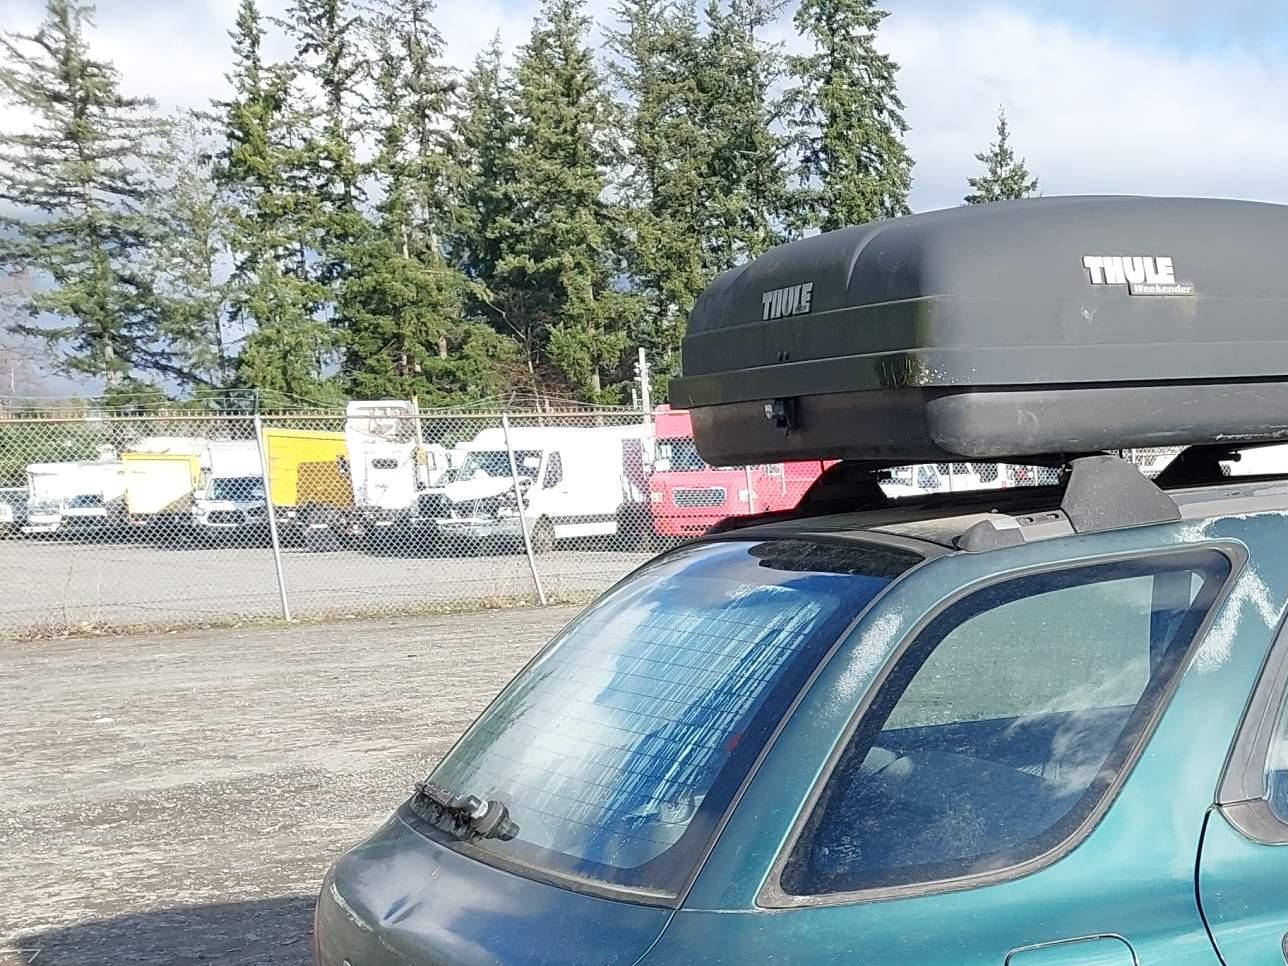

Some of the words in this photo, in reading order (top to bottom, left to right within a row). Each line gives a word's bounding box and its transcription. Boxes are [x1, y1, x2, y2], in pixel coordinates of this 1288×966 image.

[1082, 255, 1176, 285] THULE
[762, 281, 814, 321] THULE
[1133, 284, 1192, 294] Weekender
